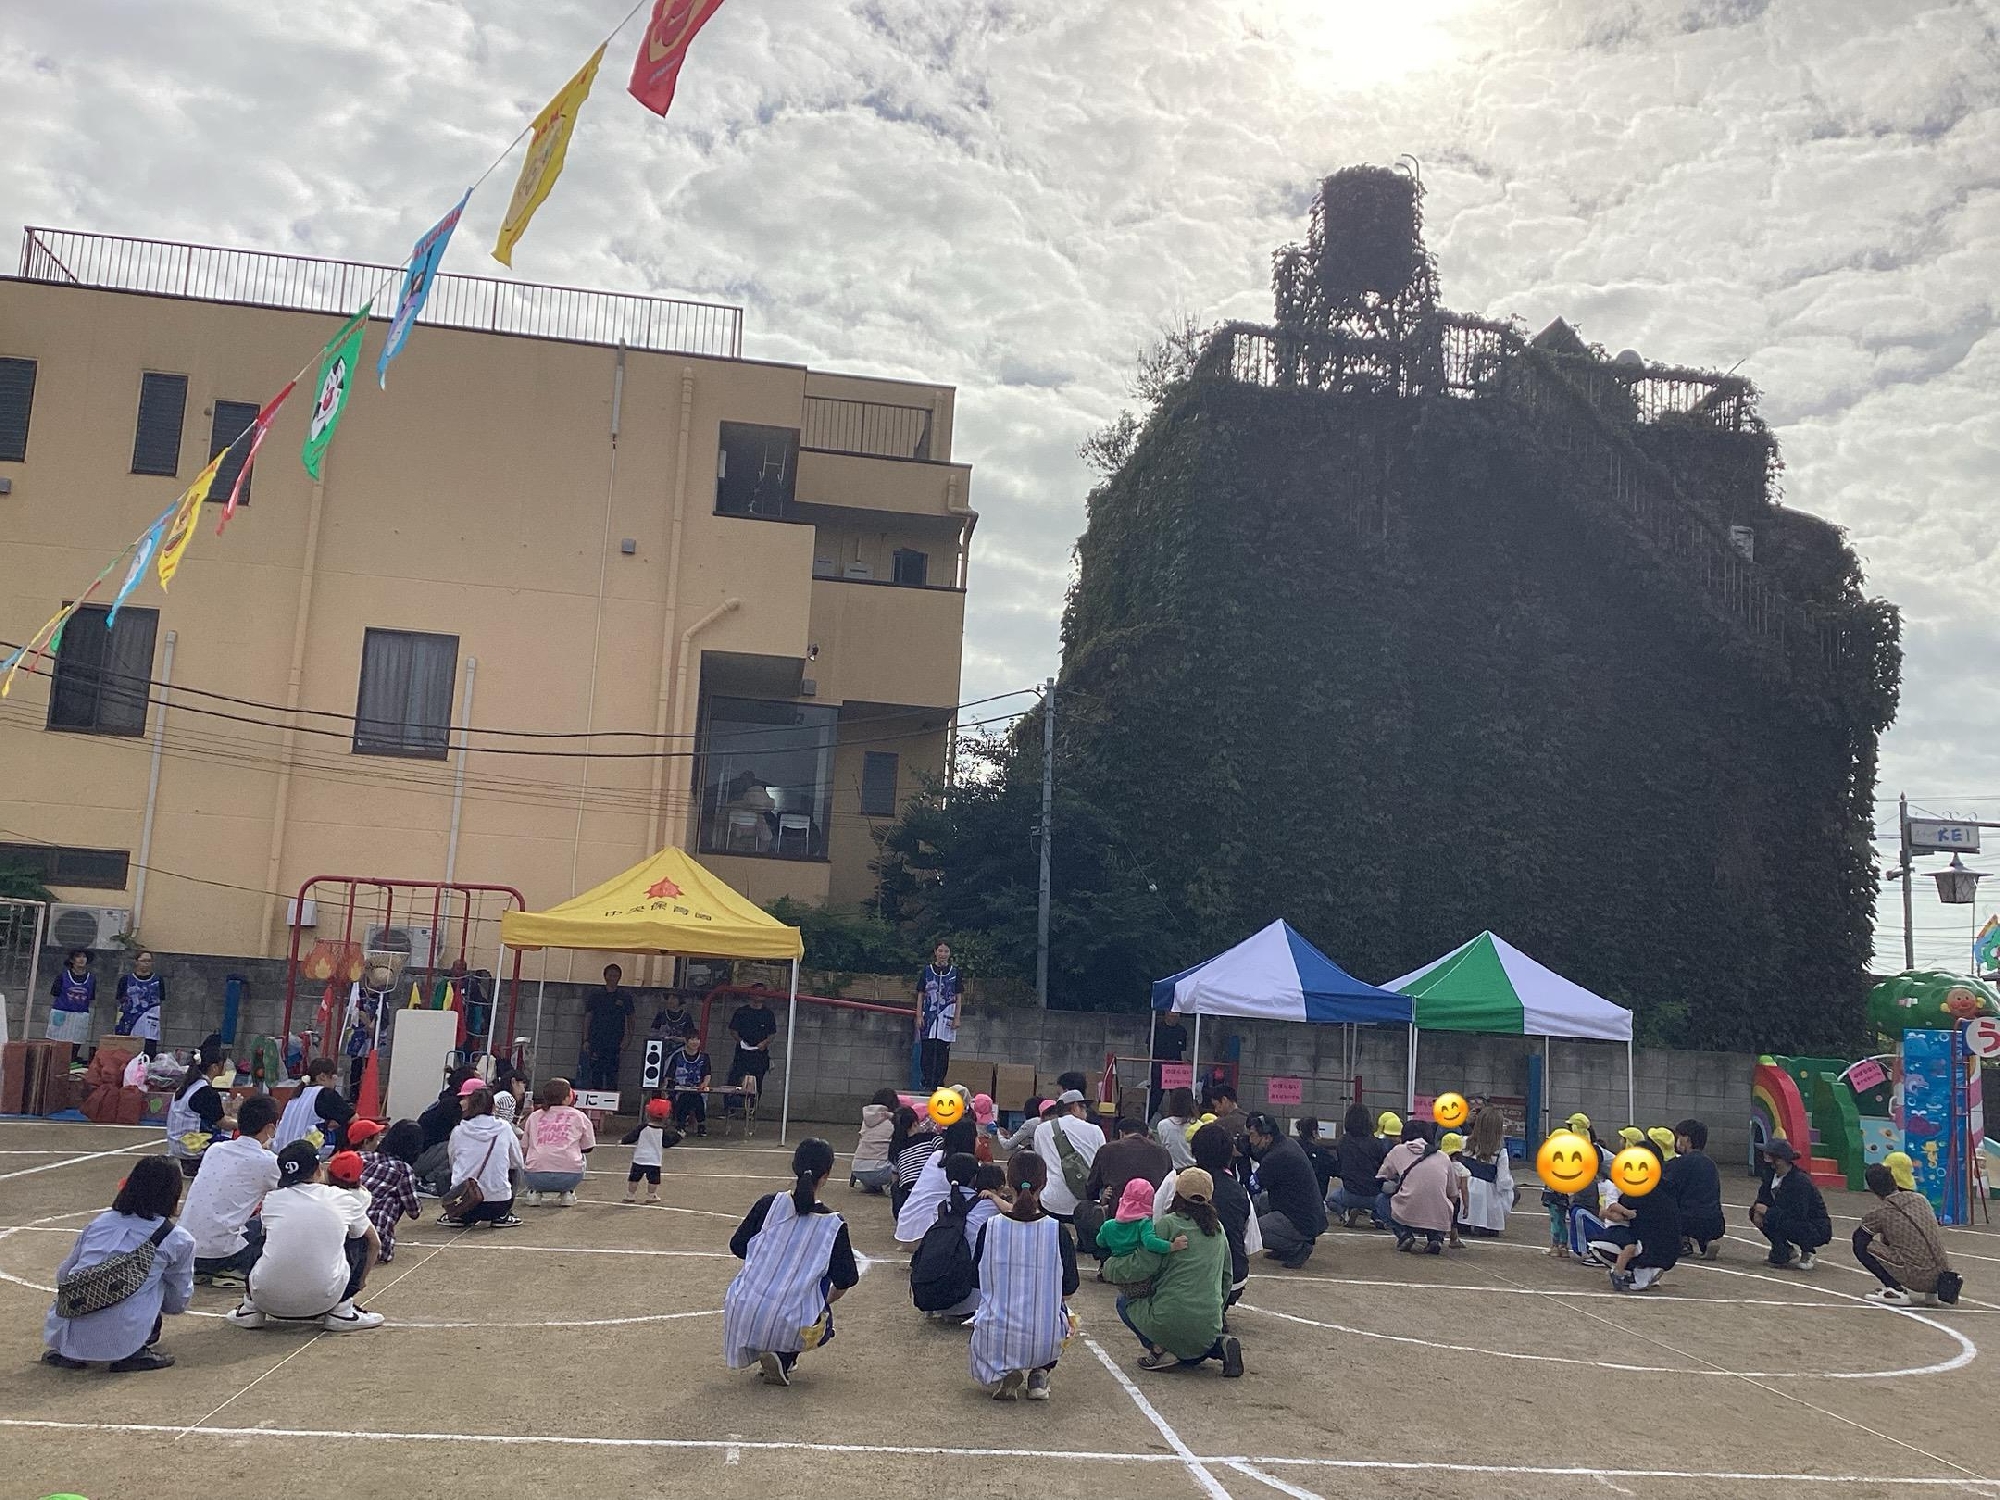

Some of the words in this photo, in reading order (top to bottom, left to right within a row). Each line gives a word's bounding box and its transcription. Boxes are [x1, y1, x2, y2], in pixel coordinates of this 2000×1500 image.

[1937, 827, 1971, 842] KEI
[1977, 1021, 2000, 1054] う
[575, 1094, 616, 1106] にー
